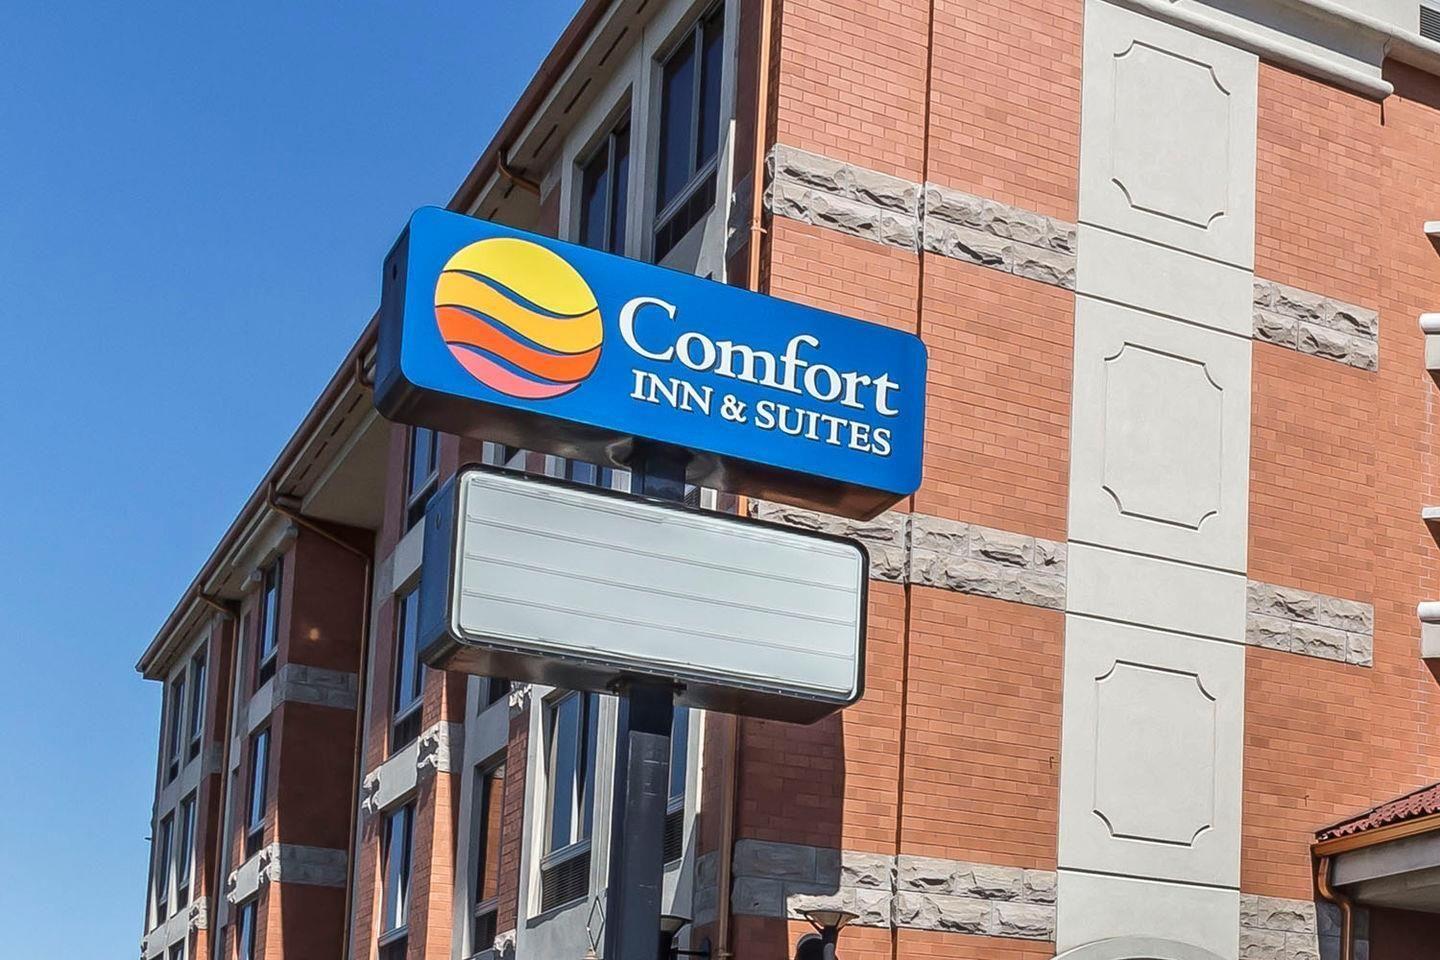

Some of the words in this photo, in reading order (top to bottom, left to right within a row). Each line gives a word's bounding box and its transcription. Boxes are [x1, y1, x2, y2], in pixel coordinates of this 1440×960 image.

[618, 296, 900, 417] Comfort
[629, 368, 714, 416] INN
[719, 393, 747, 424] &
[754, 399, 892, 456] SUITES
